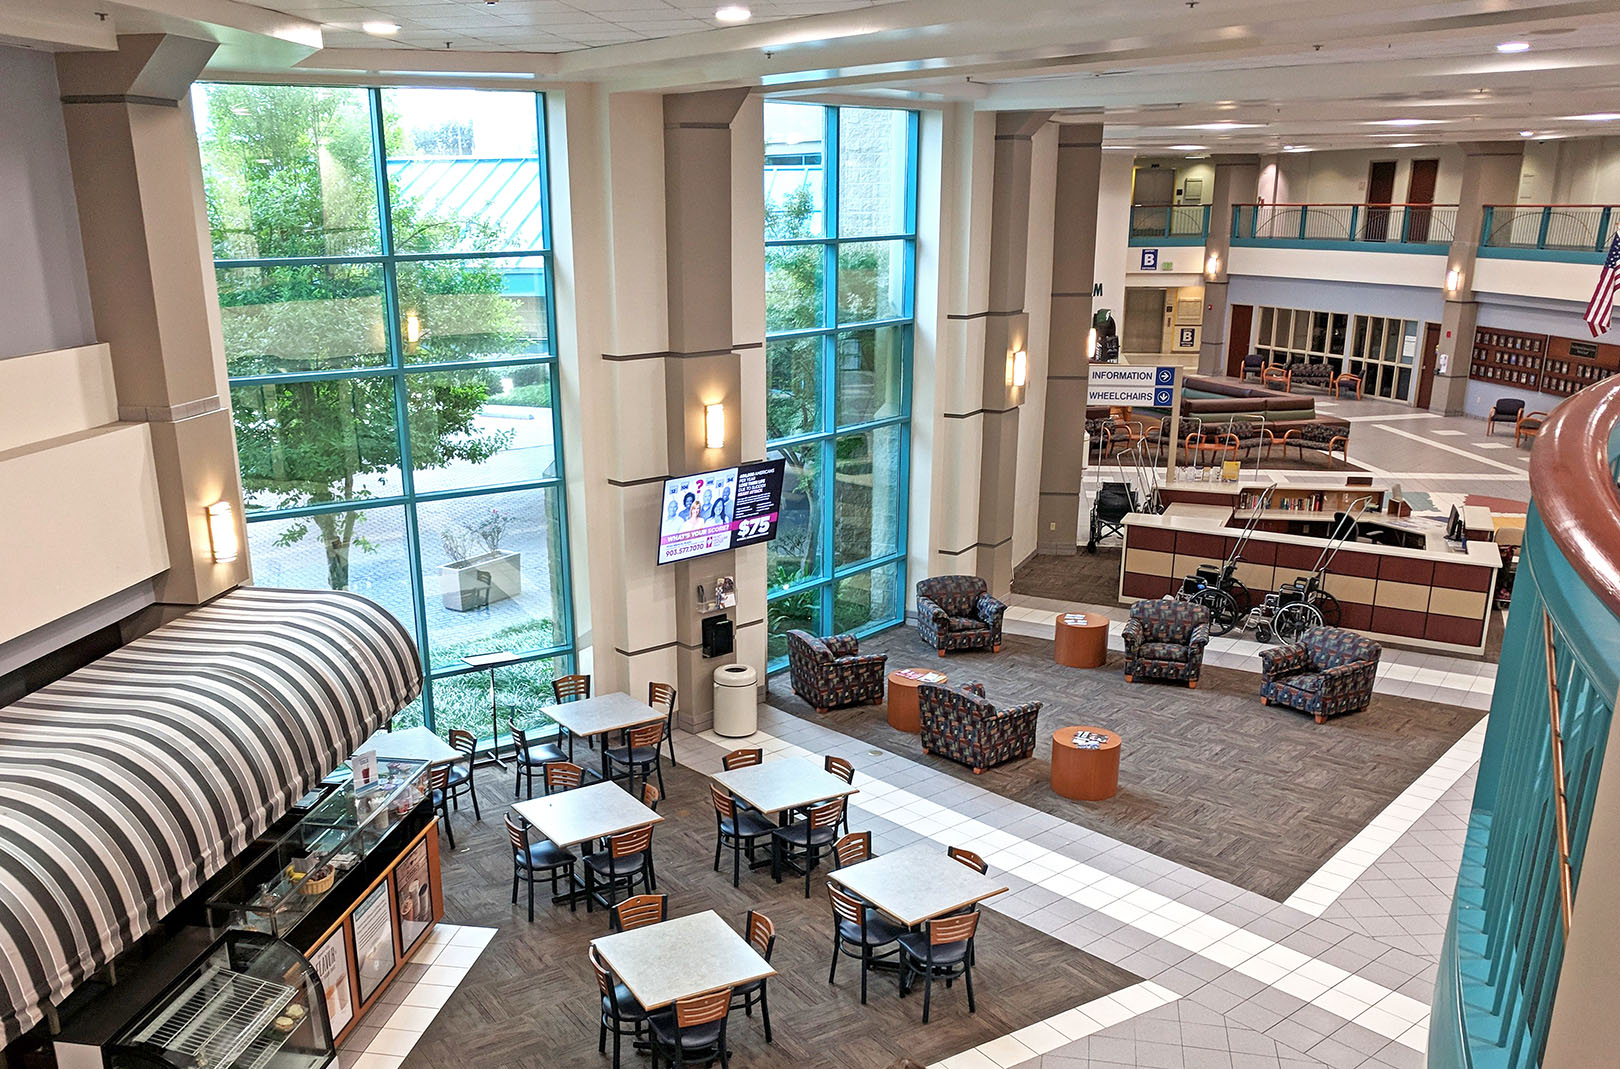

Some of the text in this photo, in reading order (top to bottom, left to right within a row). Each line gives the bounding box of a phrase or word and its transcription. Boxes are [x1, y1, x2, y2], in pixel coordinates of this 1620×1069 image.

[1144, 253, 1155, 266] B
[1183, 332, 1192, 341] B
[1092, 371, 1153, 381] INFORMATION
[1089, 391, 1153, 402] WHEELCHAIRS
[738, 515, 771, 538] $75
[691, 529, 707, 538] YOUR
